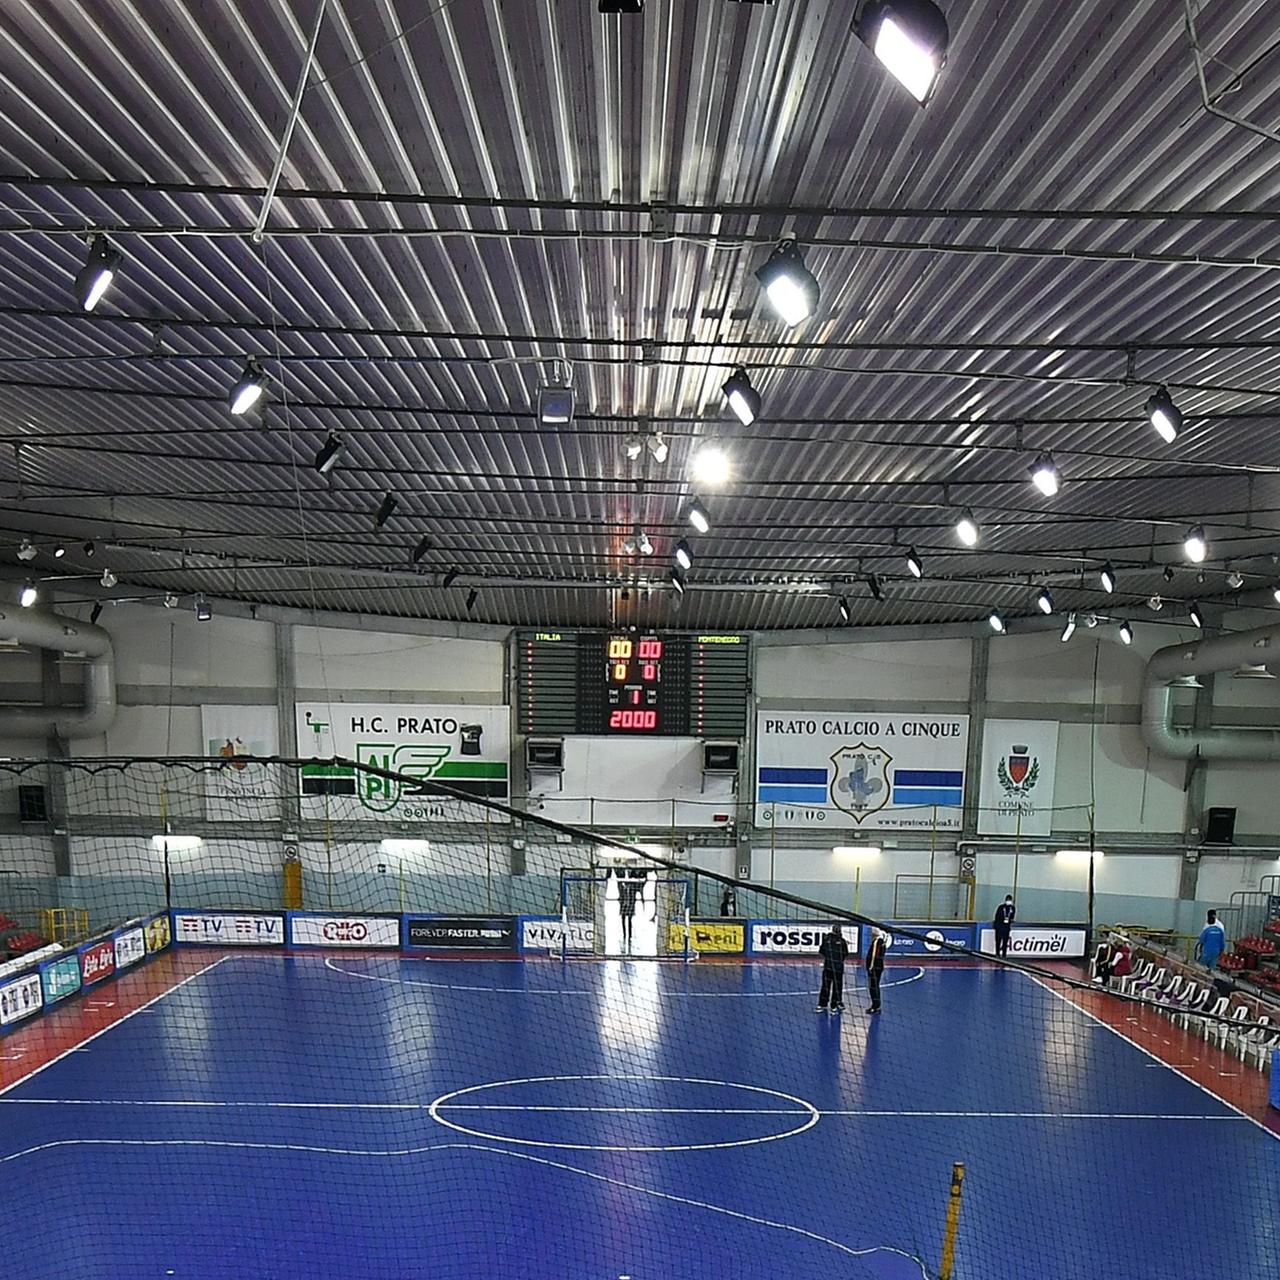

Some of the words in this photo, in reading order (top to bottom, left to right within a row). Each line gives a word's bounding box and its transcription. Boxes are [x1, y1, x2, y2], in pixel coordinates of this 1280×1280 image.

[535, 633, 561, 641] ITALIA
[609, 640, 632, 658] 00
[639, 641, 662, 658] 00
[615, 664, 626, 679] 0
[644, 664, 655, 680] 0
[351, 717, 388, 733] H.C.
[398, 718, 458, 734] PRATO
[765, 720, 816, 735] PRATO
[822, 721, 880, 735] CALCIO
[885, 722, 896, 736] A
[902, 722, 961, 738] CINQUE
[1006, 934, 1067, 952] Actimel
